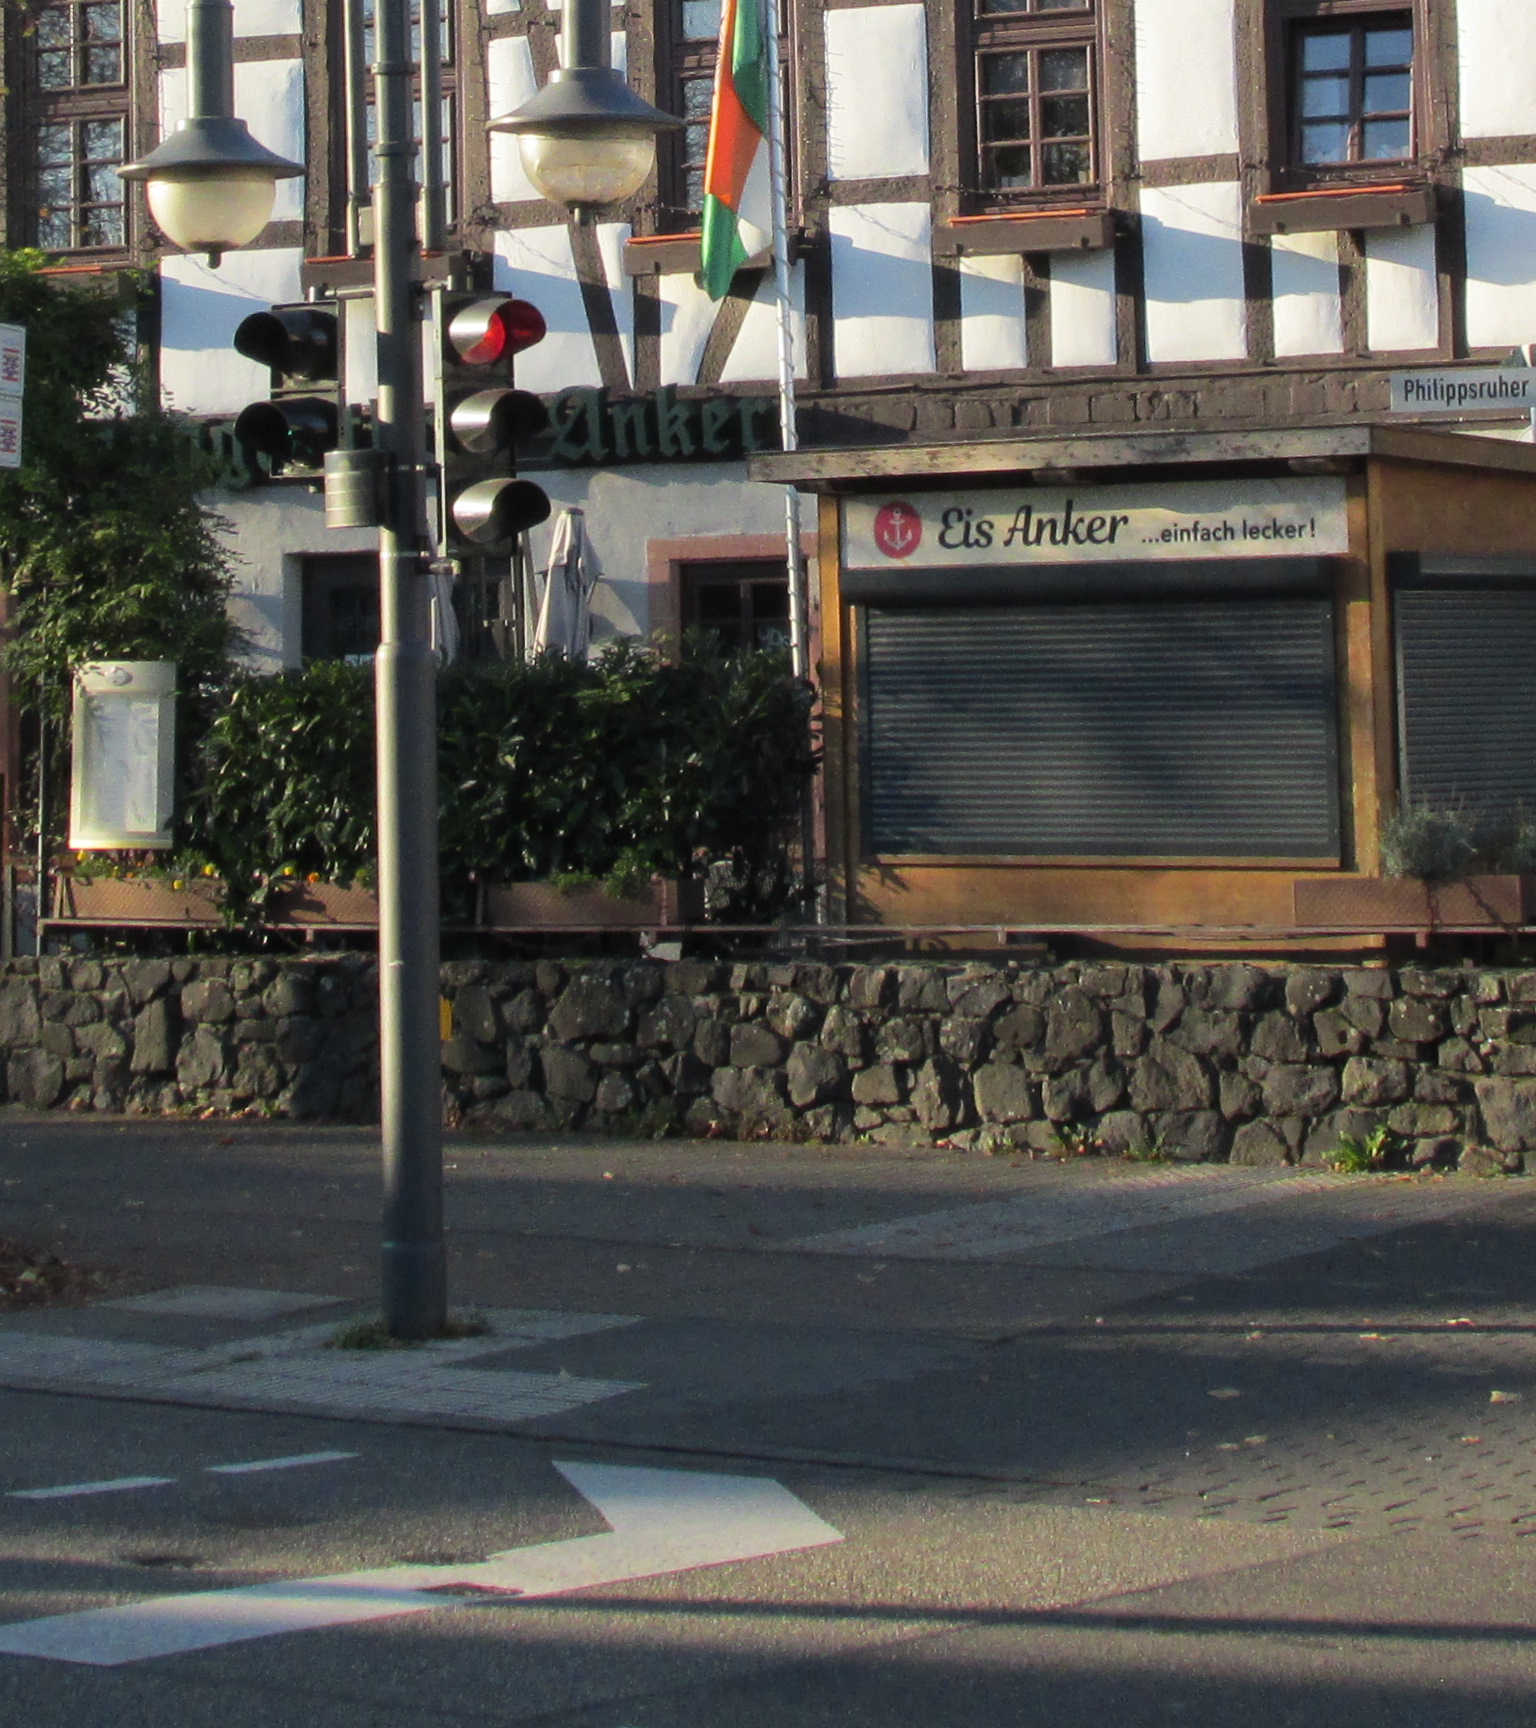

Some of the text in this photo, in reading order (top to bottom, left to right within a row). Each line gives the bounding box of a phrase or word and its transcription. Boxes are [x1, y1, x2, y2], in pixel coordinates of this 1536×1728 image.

[1403, 375, 1530, 407] Philippsruher
[548, 383, 779, 462] Anker
[937, 499, 1318, 550] Eis Anker ...einfach lecker!
